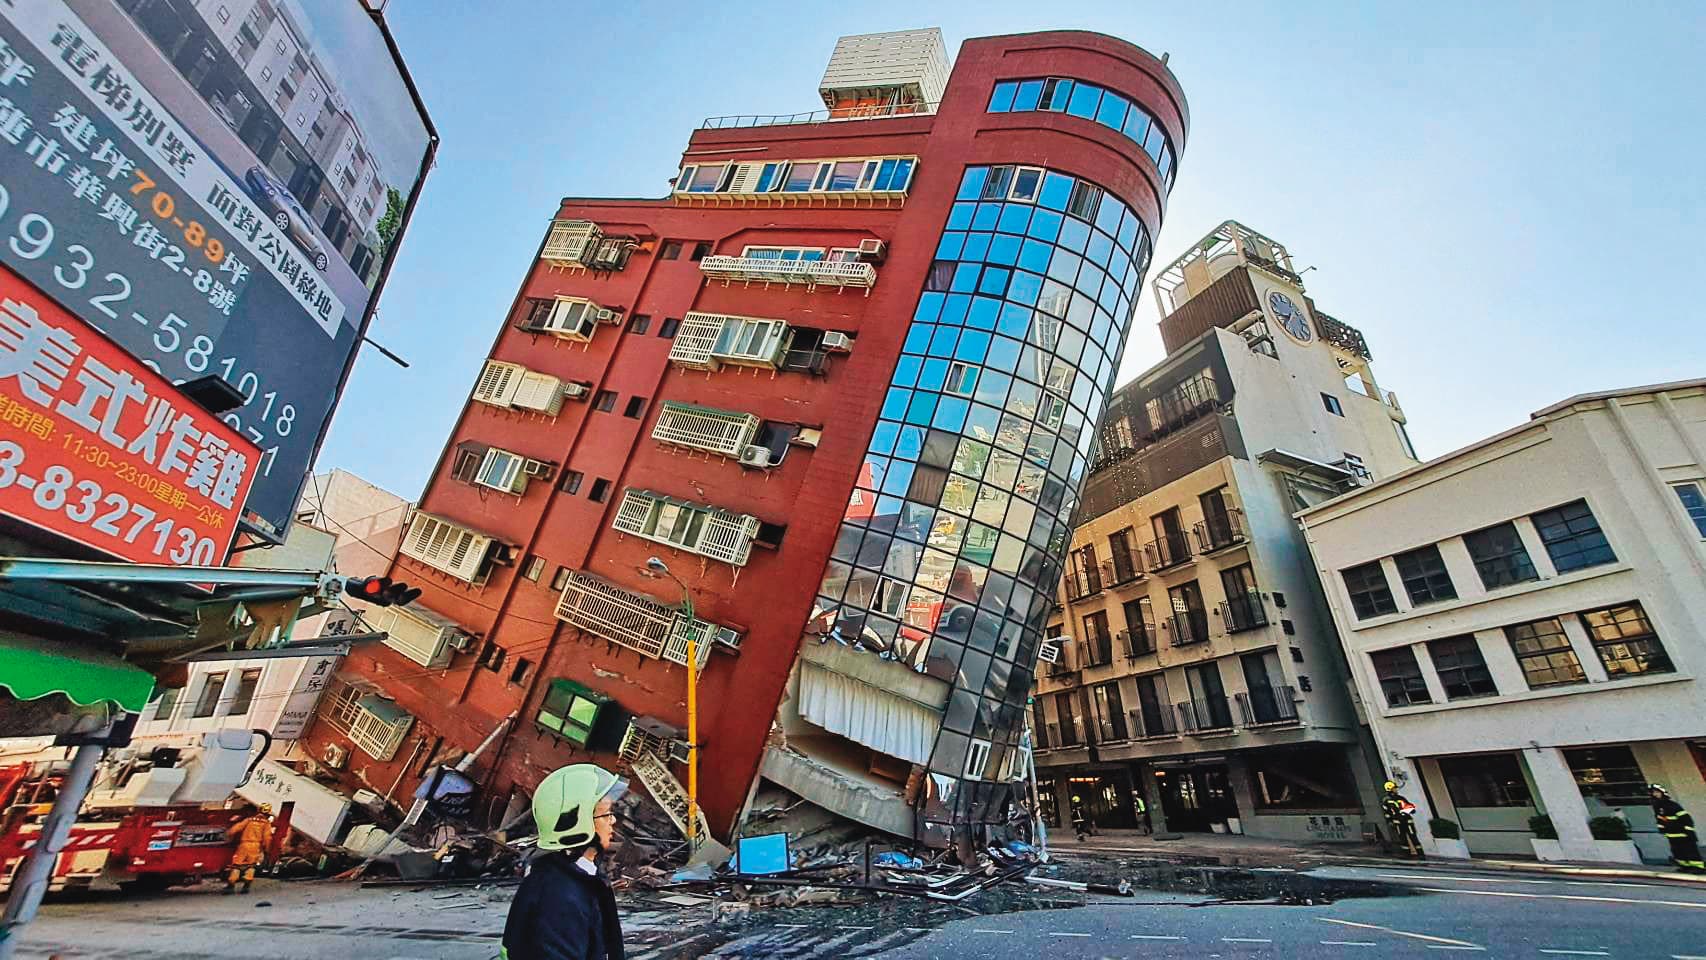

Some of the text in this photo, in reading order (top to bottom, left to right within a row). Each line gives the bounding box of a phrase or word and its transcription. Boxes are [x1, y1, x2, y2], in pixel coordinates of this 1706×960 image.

[50, 23, 196, 178] 電梯別墅
[207, 180, 333, 321] 面對公園綠地
[0, 183, 296, 437] 932-581018
[0, 297, 247, 510] 美式炸雞
